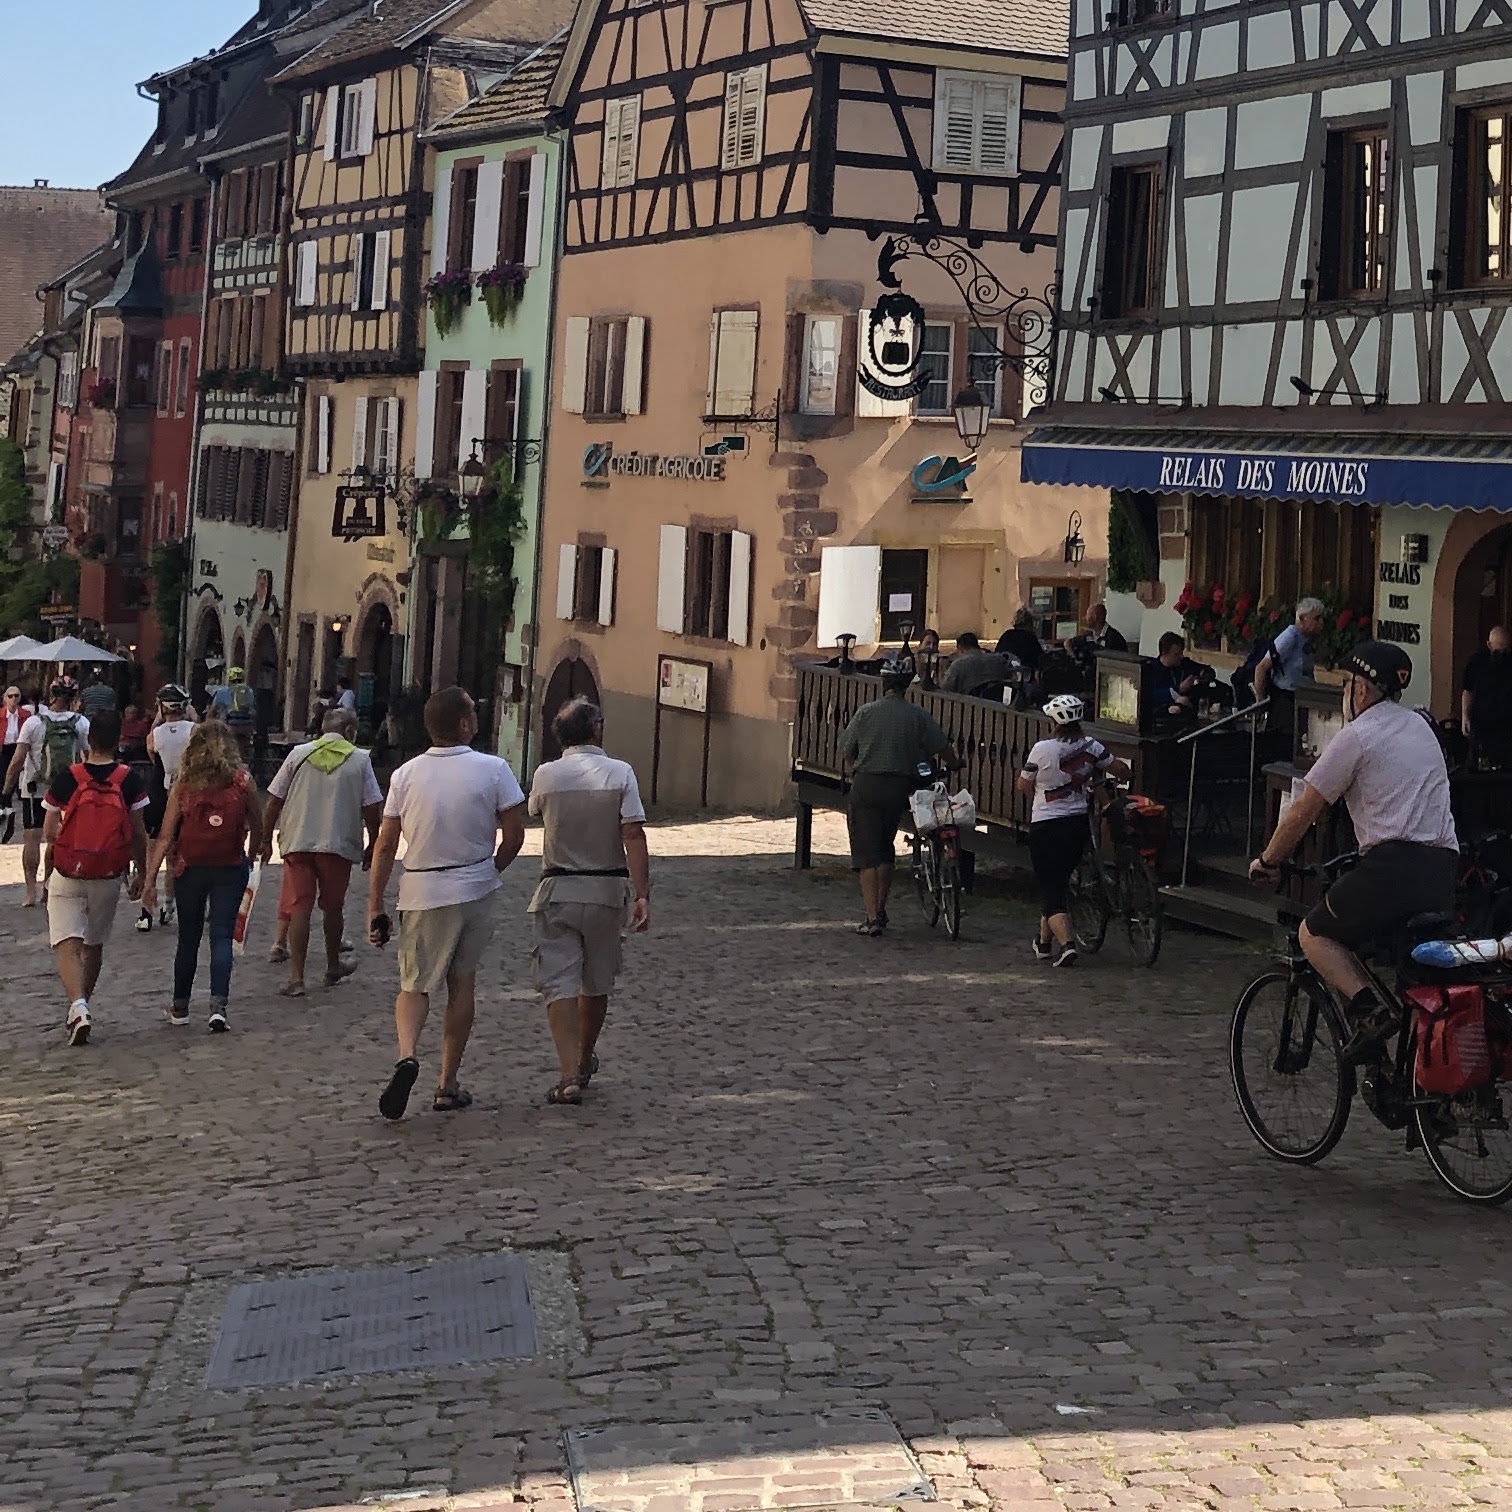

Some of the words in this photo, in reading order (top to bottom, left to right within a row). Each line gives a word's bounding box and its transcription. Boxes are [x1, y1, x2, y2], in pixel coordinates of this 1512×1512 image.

[611, 451, 652, 476] CRÉDIT
[657, 456, 722, 481] AGRICOLE
[1159, 456, 1226, 489] RELAIS
[1236, 459, 1276, 492] DES
[1286, 460, 1369, 496] MOINES
[1380, 562, 1420, 585] RELAIS
